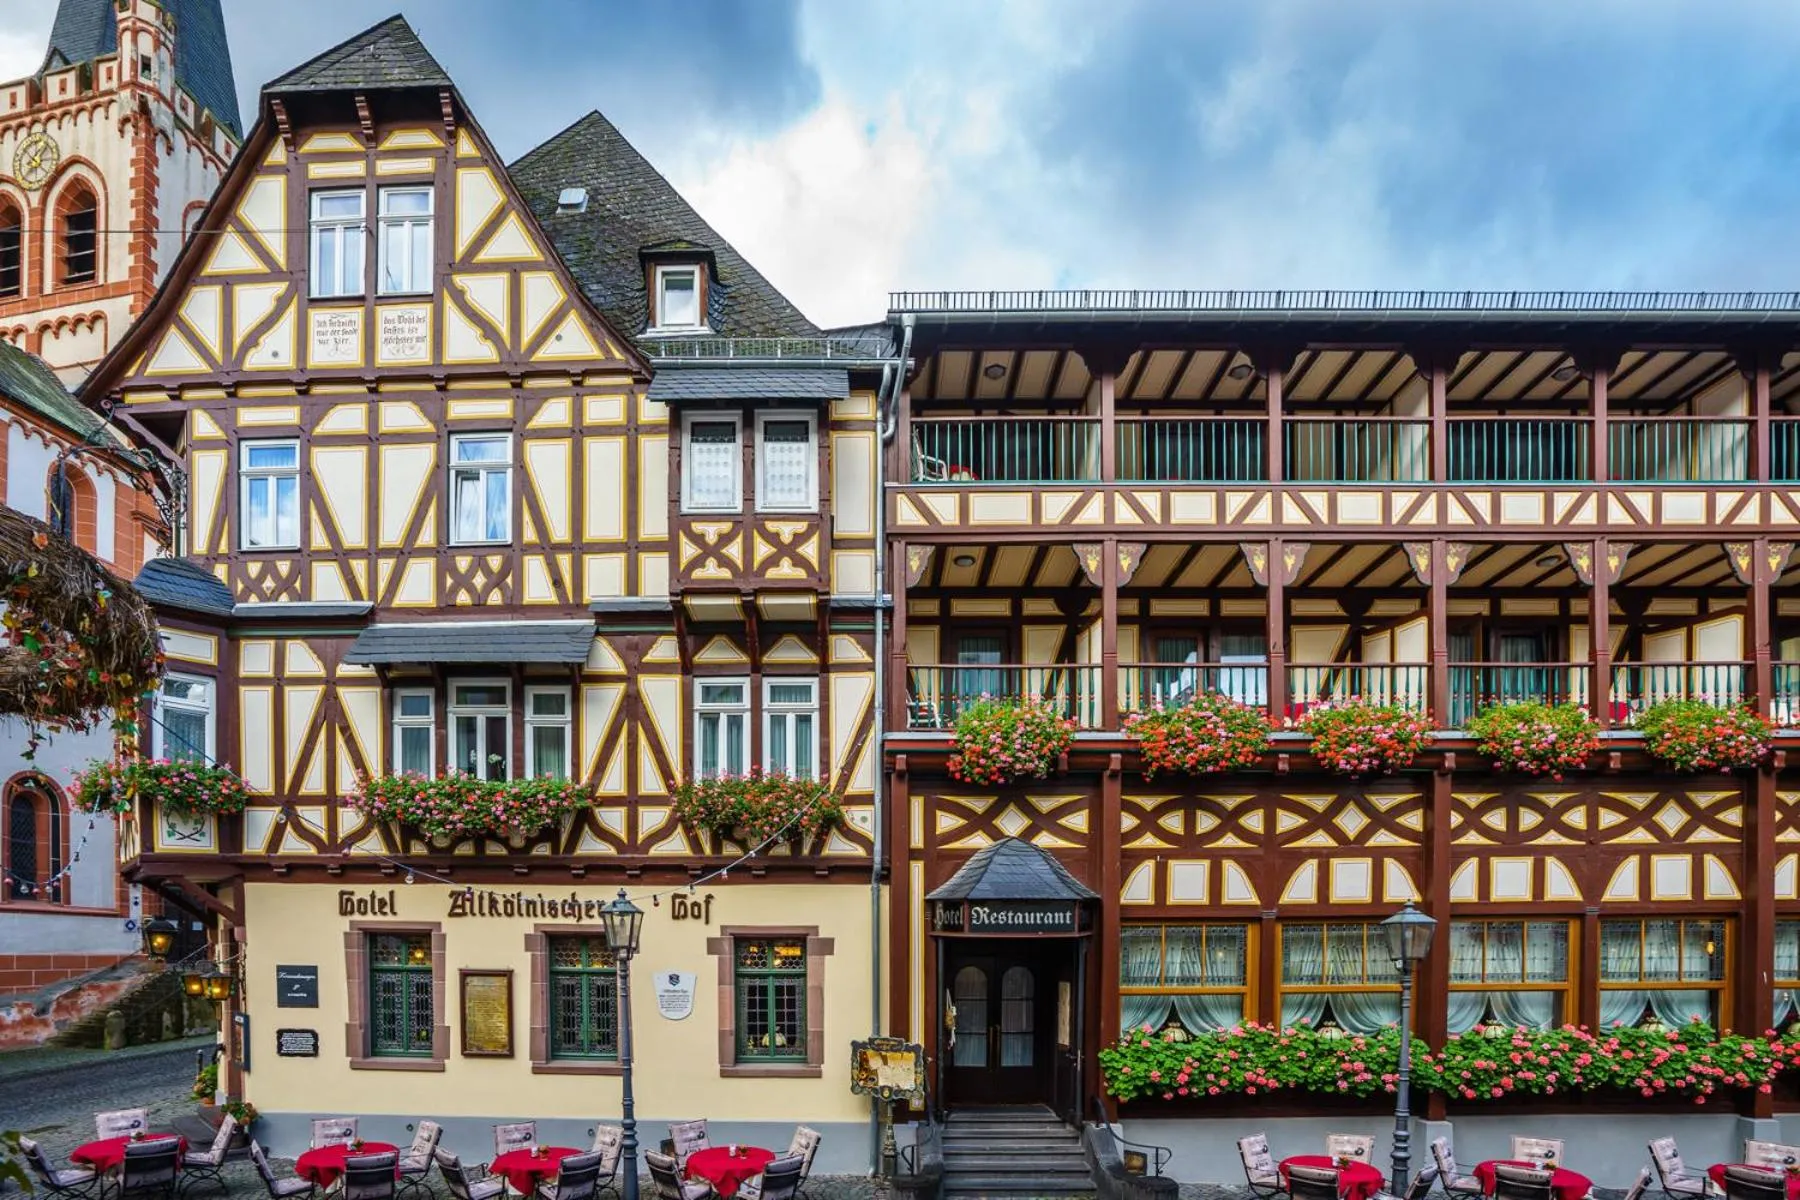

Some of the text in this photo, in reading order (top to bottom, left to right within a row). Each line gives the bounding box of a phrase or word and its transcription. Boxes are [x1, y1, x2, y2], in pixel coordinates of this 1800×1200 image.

[338, 889, 715, 925] Hotel Altkölnischer Hof
[934, 901, 1073, 932] Hotel Restaurant
